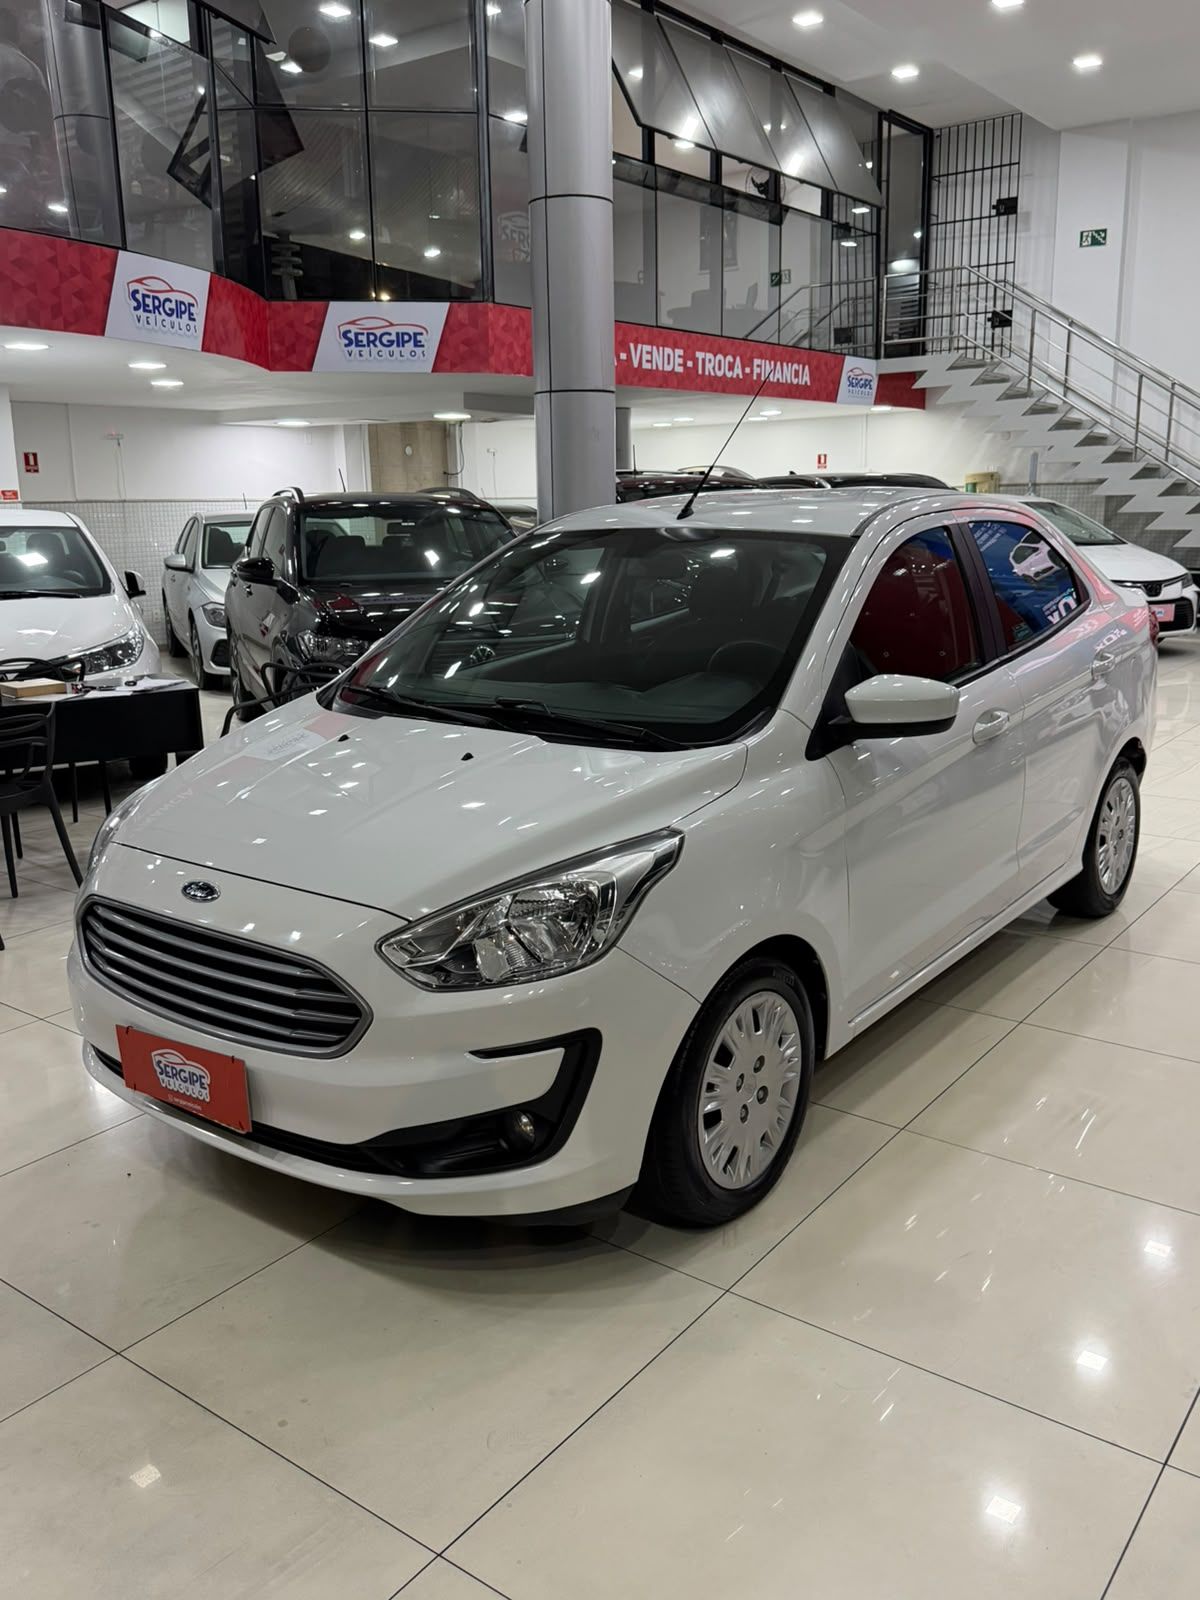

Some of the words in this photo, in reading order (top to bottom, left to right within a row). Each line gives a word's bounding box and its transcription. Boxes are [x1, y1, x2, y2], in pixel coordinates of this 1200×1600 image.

[131, 288, 197, 322] SERGIPE
[135, 314, 198, 334] VEÍCULOS
[342, 329, 425, 348] SERGIPE
[347, 348, 426, 358] VEÍCULOS
[629, 342, 684, 373] VENDE
[695, 351, 743, 379] TROCA
[753, 358, 811, 386] FINANCIA
[156, 1060, 207, 1090] SERGIPE
